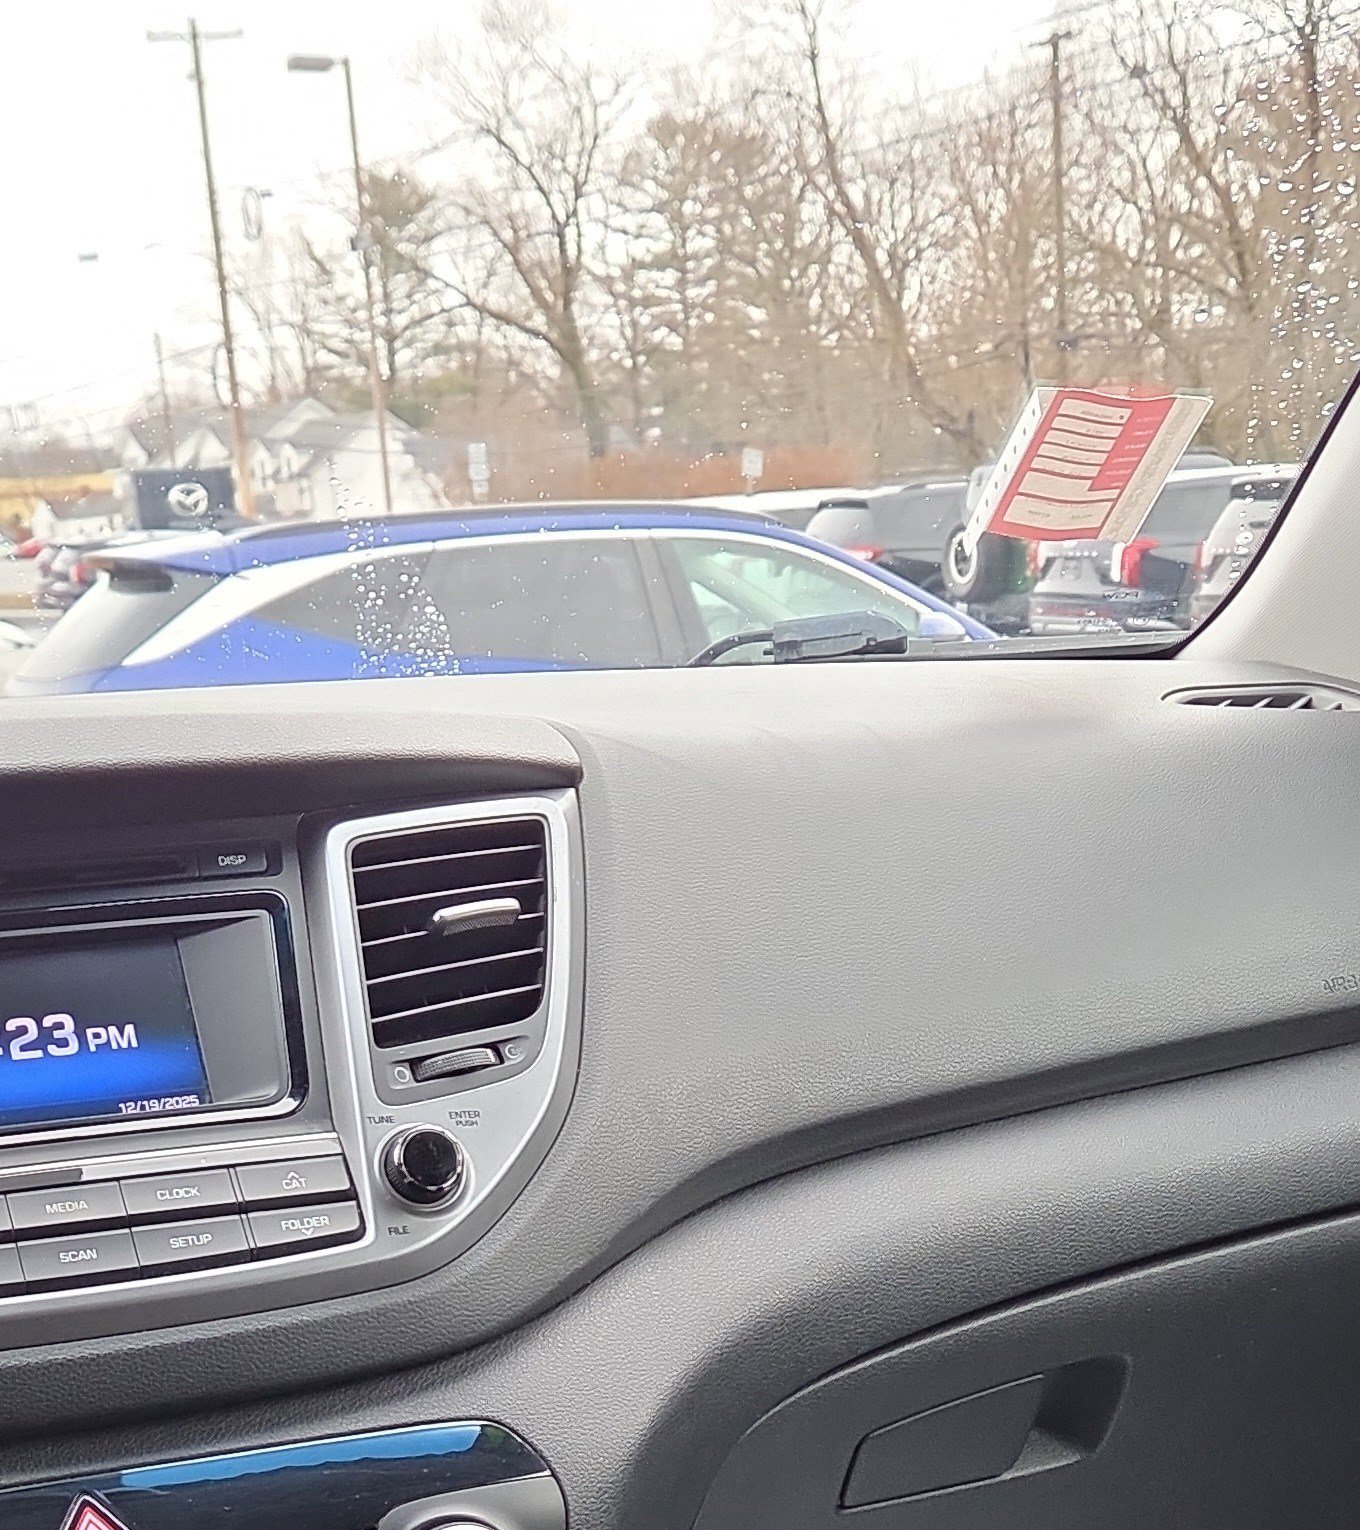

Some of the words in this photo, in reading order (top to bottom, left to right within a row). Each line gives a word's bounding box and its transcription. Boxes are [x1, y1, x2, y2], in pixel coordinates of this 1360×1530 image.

[218, 854, 247, 867] DISP
[85, 1023, 138, 1052] PM
[118, 1094, 200, 1114] 12/19/2025
[367, 1115, 396, 1125] TUNE
[448, 1110, 481, 1120] ENTER
[455, 1119, 479, 1128] PUSH
[282, 1177, 309, 1191] CAT
[156, 1186, 201, 1201] CLOCK
[45, 1199, 89, 1214] MEDIA
[280, 1215, 330, 1232] FOLDER
[387, 1225, 410, 1236] FILE
[169, 1233, 213, 1249] SETUP
[59, 1248, 98, 1263] SCAN
